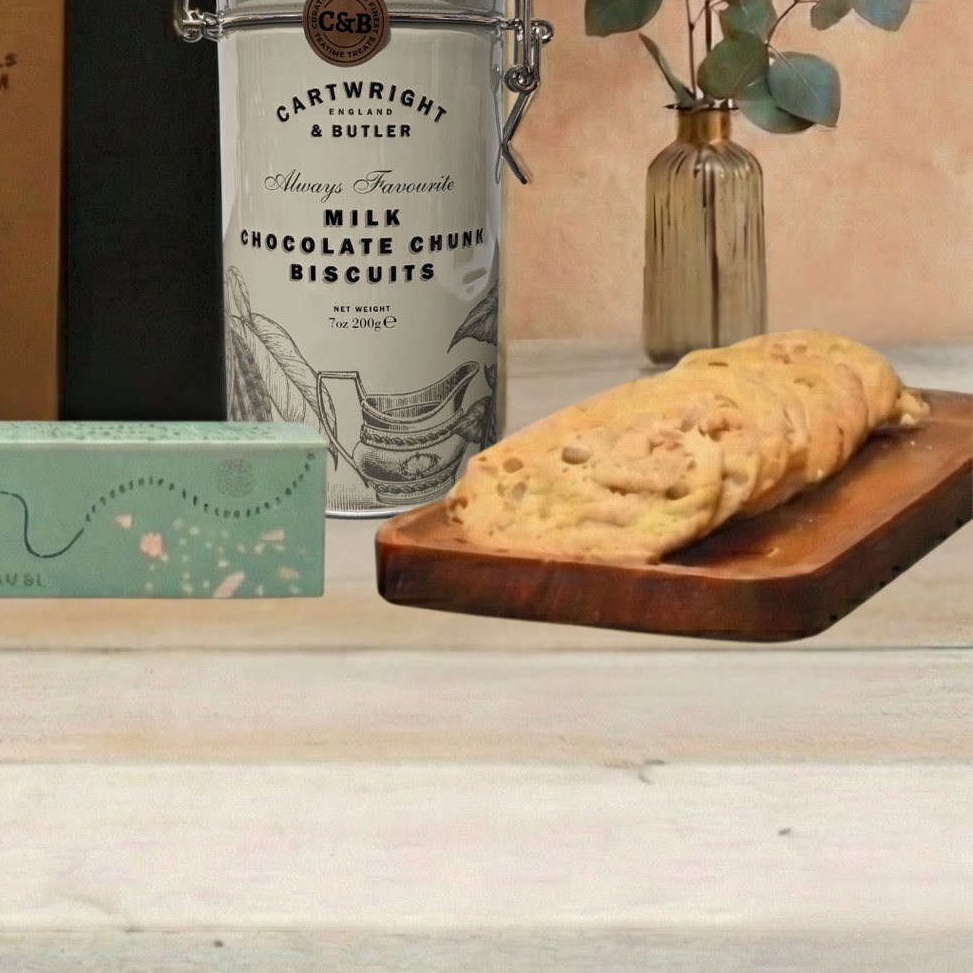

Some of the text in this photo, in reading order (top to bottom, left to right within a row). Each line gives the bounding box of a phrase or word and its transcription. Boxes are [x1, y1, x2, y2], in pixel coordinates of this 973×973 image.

[318, 10, 372, 34] C&B
[368, 2, 380, 35] FINEST
[314, 32, 376, 58] TEATIME TREATS
[276, 81, 448, 123] CARTWRIGHT
[329, 108, 393, 116] ENGLAND
[311, 124, 411, 138] & BUTLER
[264, 169, 455, 203] Always Favourite
[324, 209, 401, 227] MILK
[240, 227, 484, 256] CHOCOLATE CHUNK
[289, 262, 435, 284] BISCUITS
[355, 305, 391, 313] WEIGHT
[328, 317, 349, 329] 7oz
